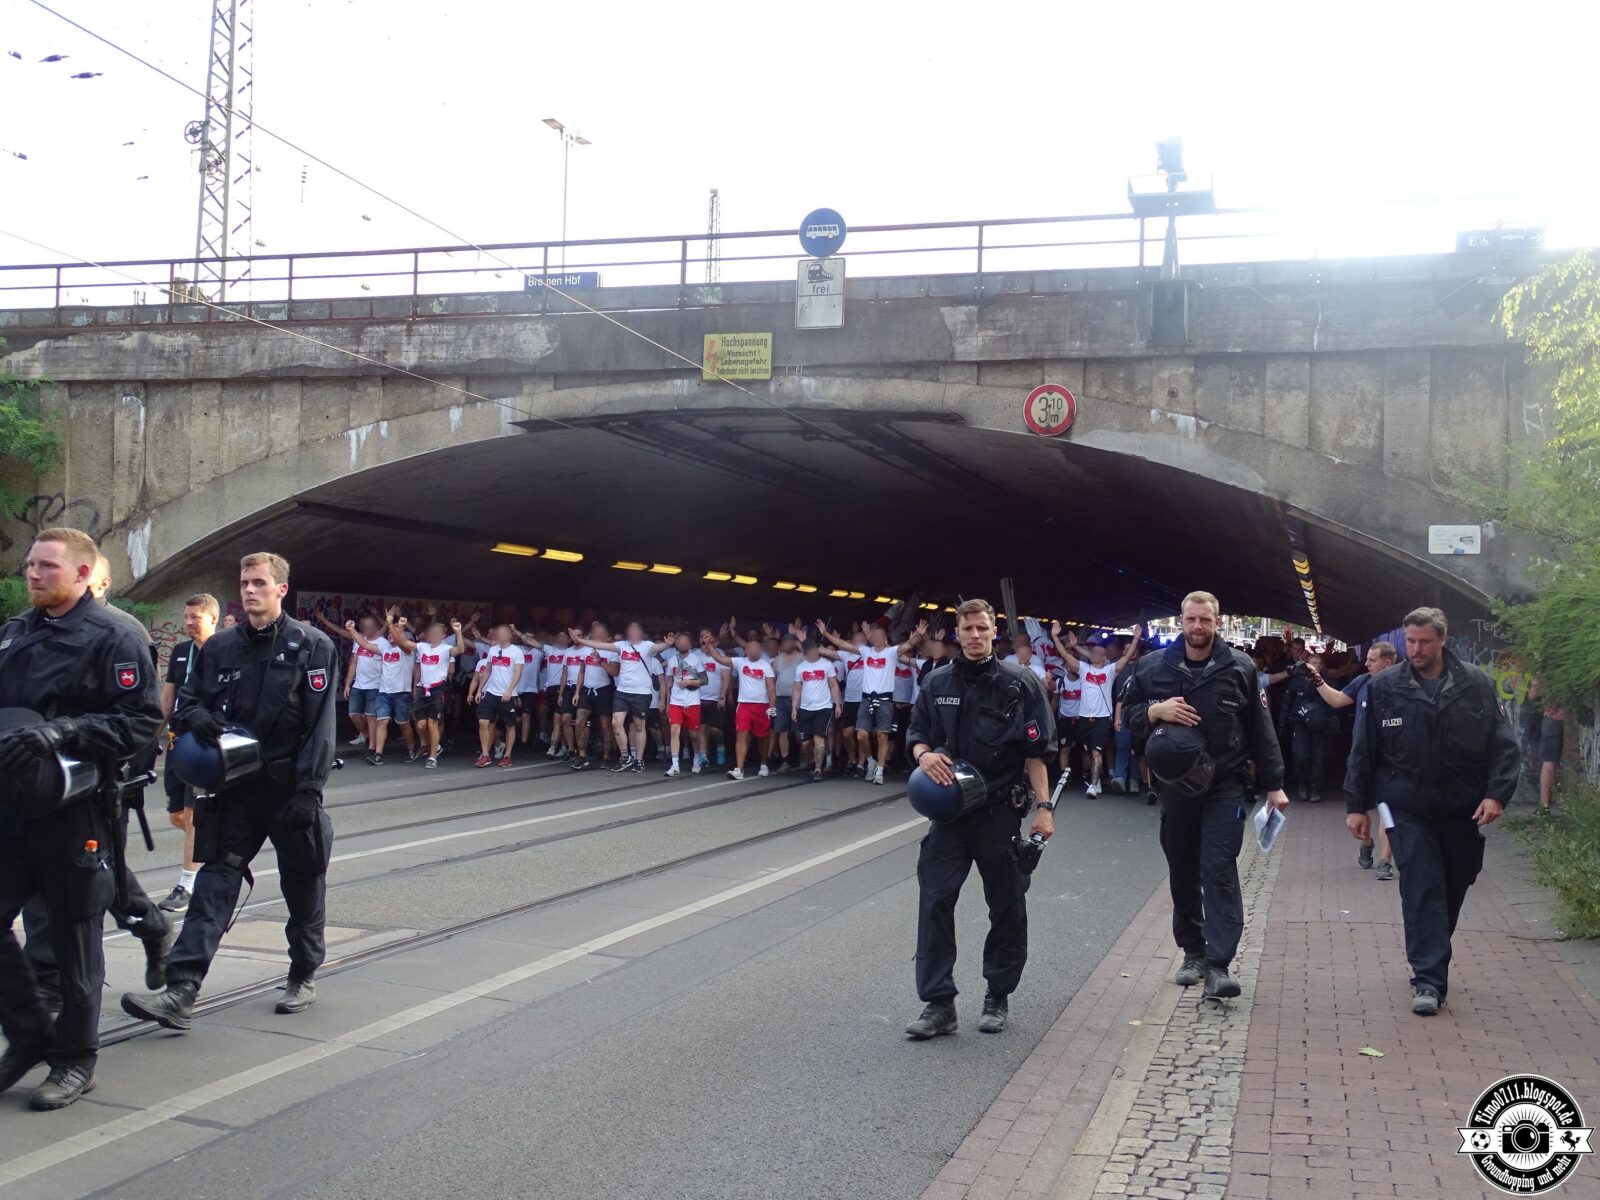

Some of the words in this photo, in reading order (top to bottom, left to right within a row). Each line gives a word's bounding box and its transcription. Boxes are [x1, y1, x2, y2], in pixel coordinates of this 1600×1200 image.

[564, 275, 581, 285] Hbf
[812, 284, 830, 294] frei
[721, 336, 768, 348] Hochspannung
[720, 358, 768, 367] Lebensgefahr
[1050, 414, 1059, 423] m
